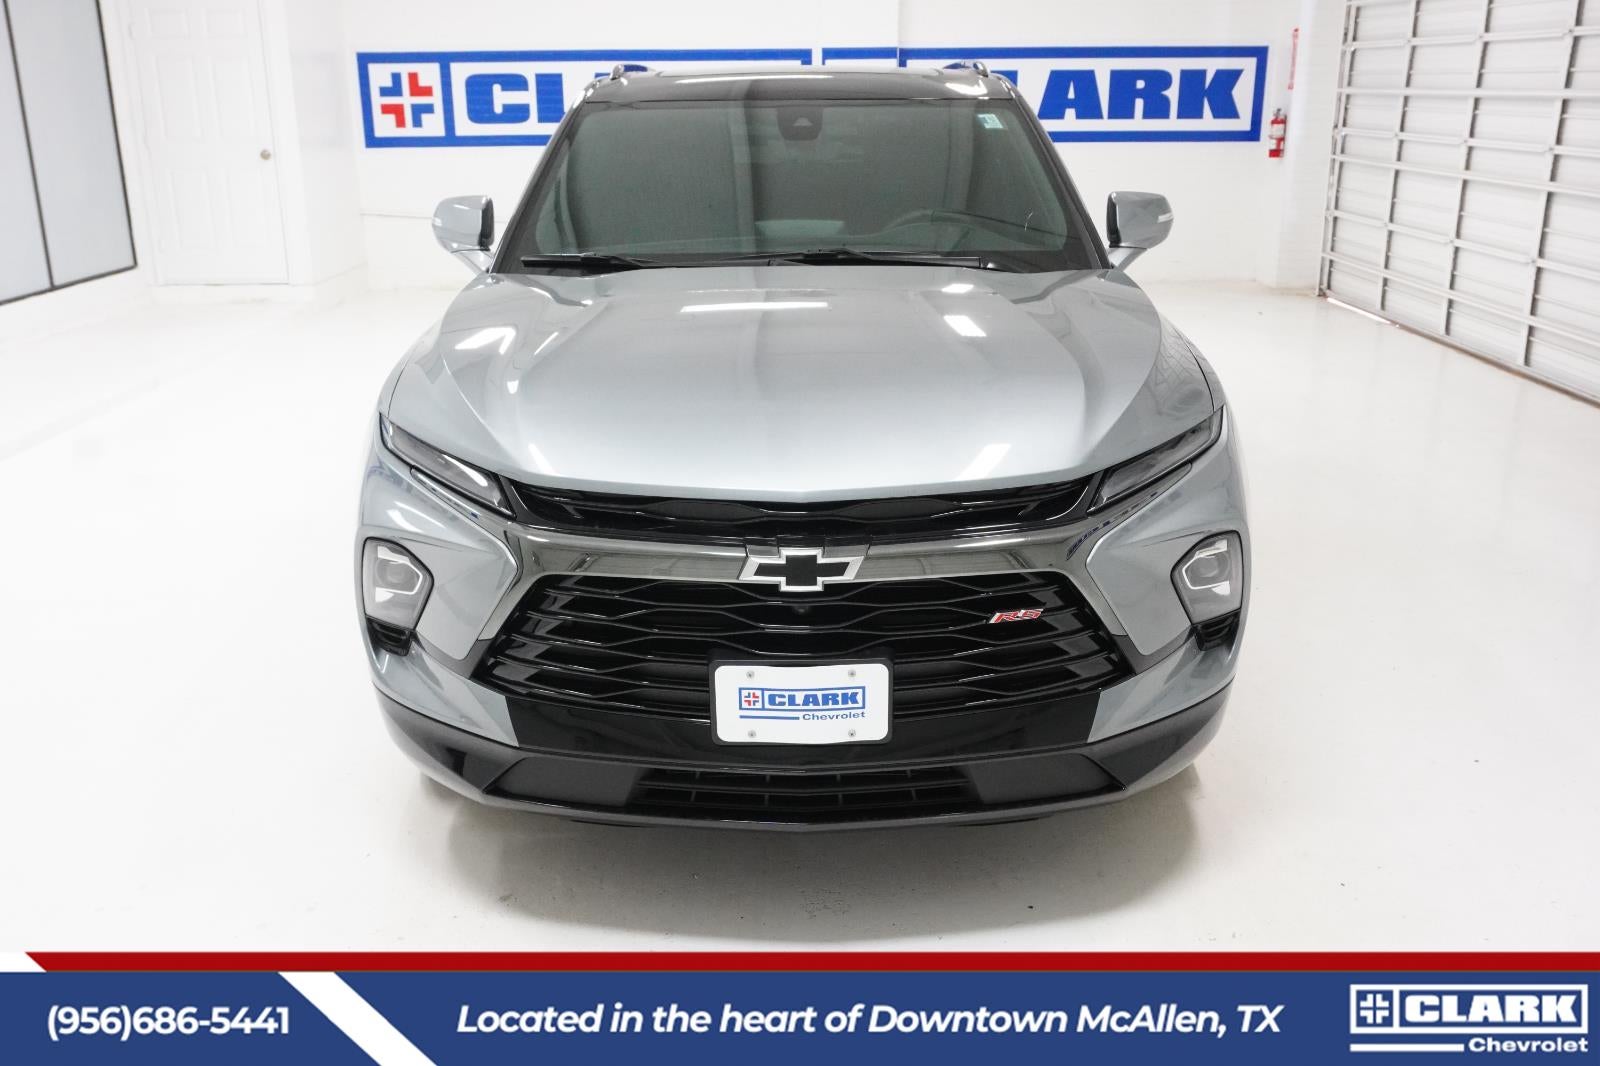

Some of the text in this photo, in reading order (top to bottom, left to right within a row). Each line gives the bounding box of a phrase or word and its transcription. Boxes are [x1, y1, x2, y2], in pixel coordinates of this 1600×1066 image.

[989, 608, 1043, 624] RS
[767, 692, 860, 707] CLARK
[802, 711, 866, 721] Chevrolet
